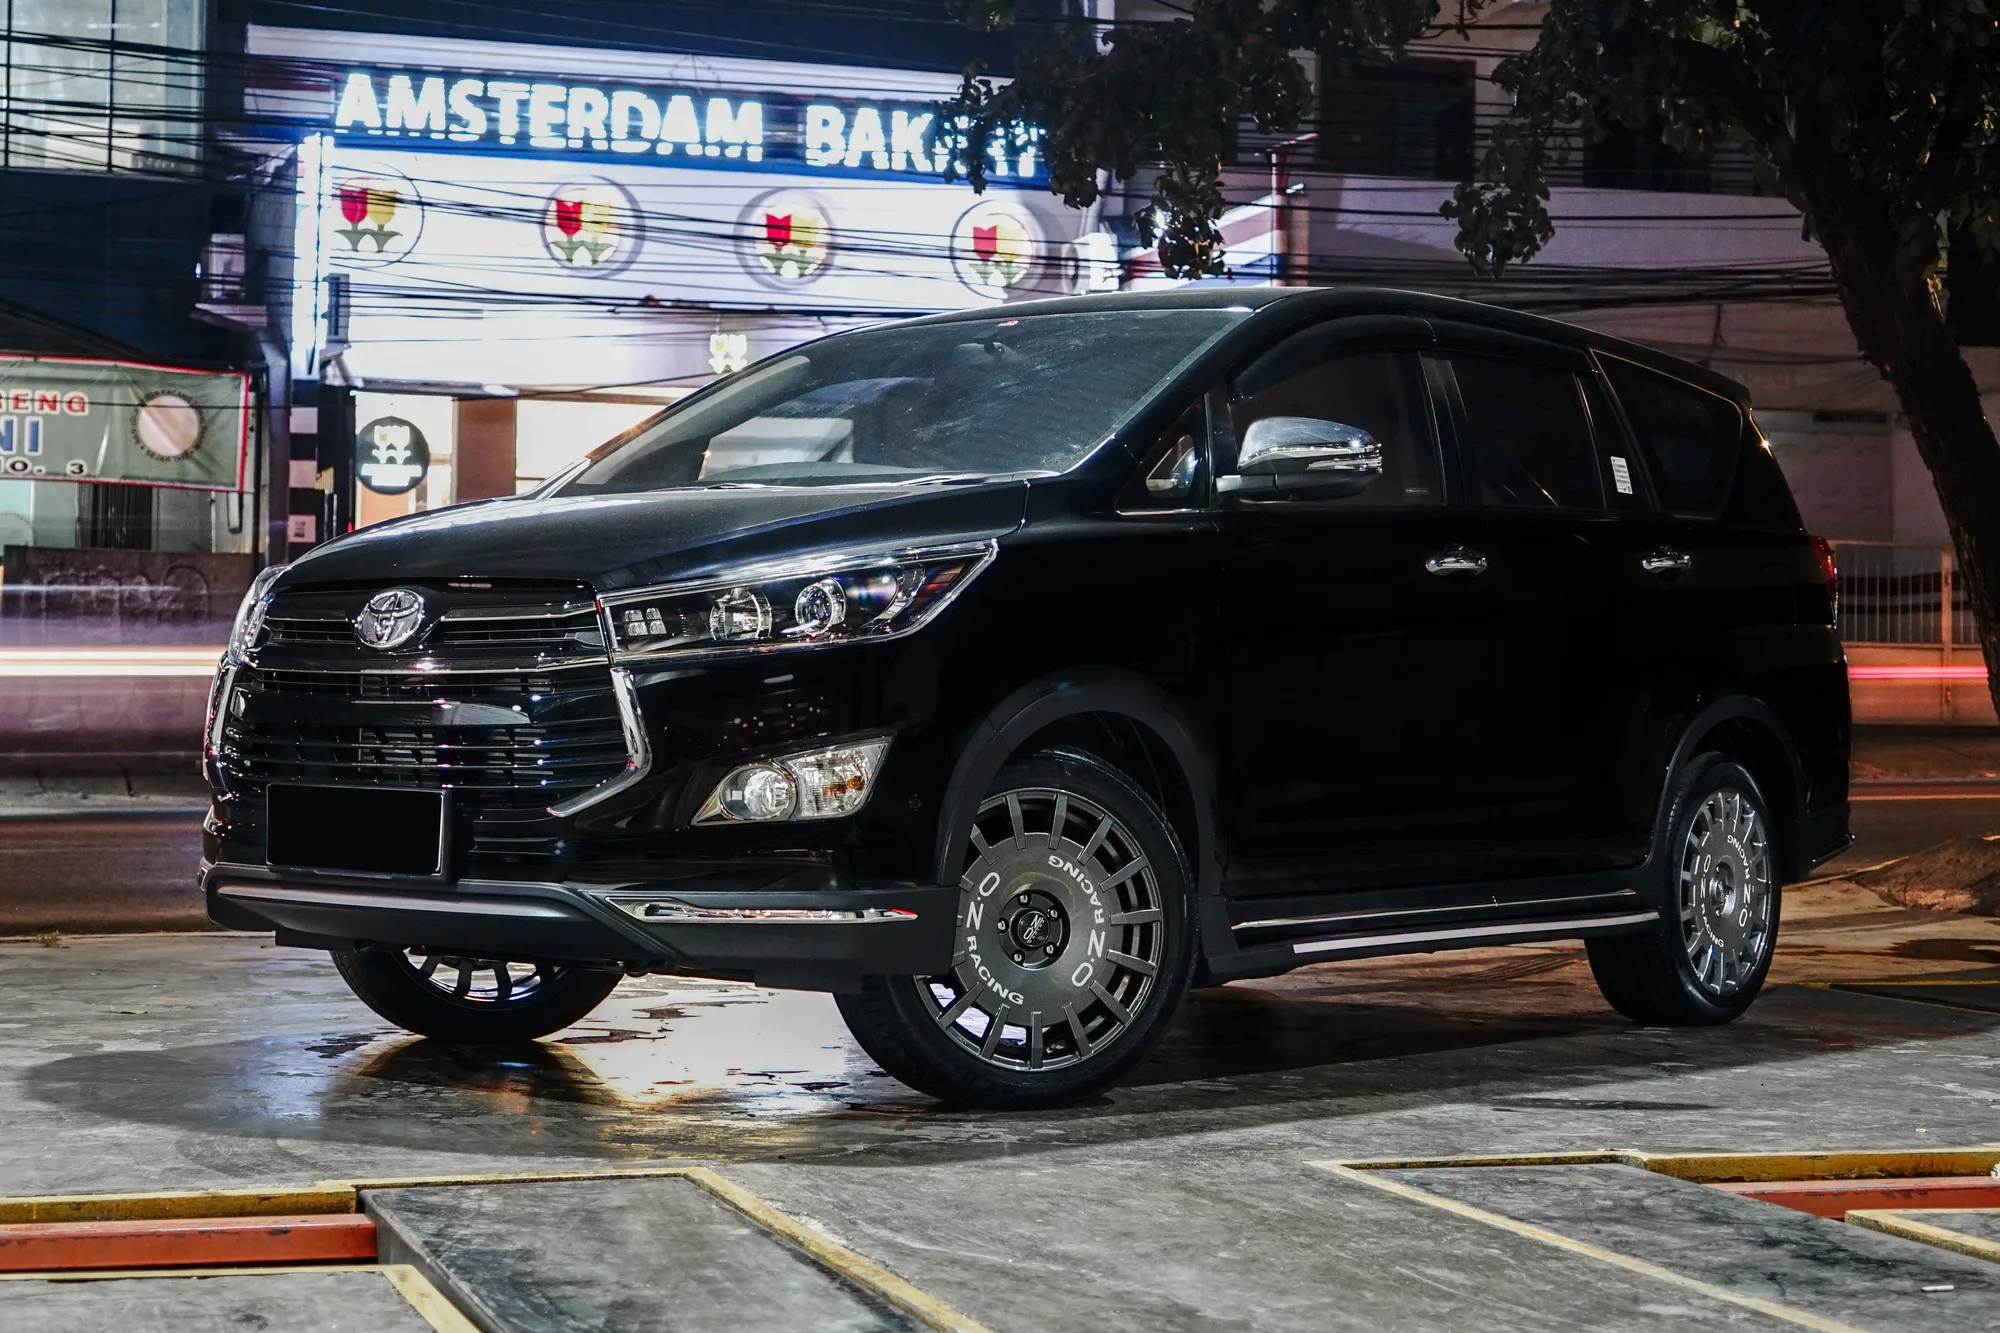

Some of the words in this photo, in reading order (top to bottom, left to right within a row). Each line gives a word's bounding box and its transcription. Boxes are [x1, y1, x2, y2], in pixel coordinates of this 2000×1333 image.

[334, 73, 764, 161] AMSTERDAM
[804, 104, 1048, 178] BAK
[0, 391, 87, 413] ENG
[69, 461, 85, 476] 3
[1047, 854, 1106, 924] RACING
[966, 935, 1025, 1006] RACING
